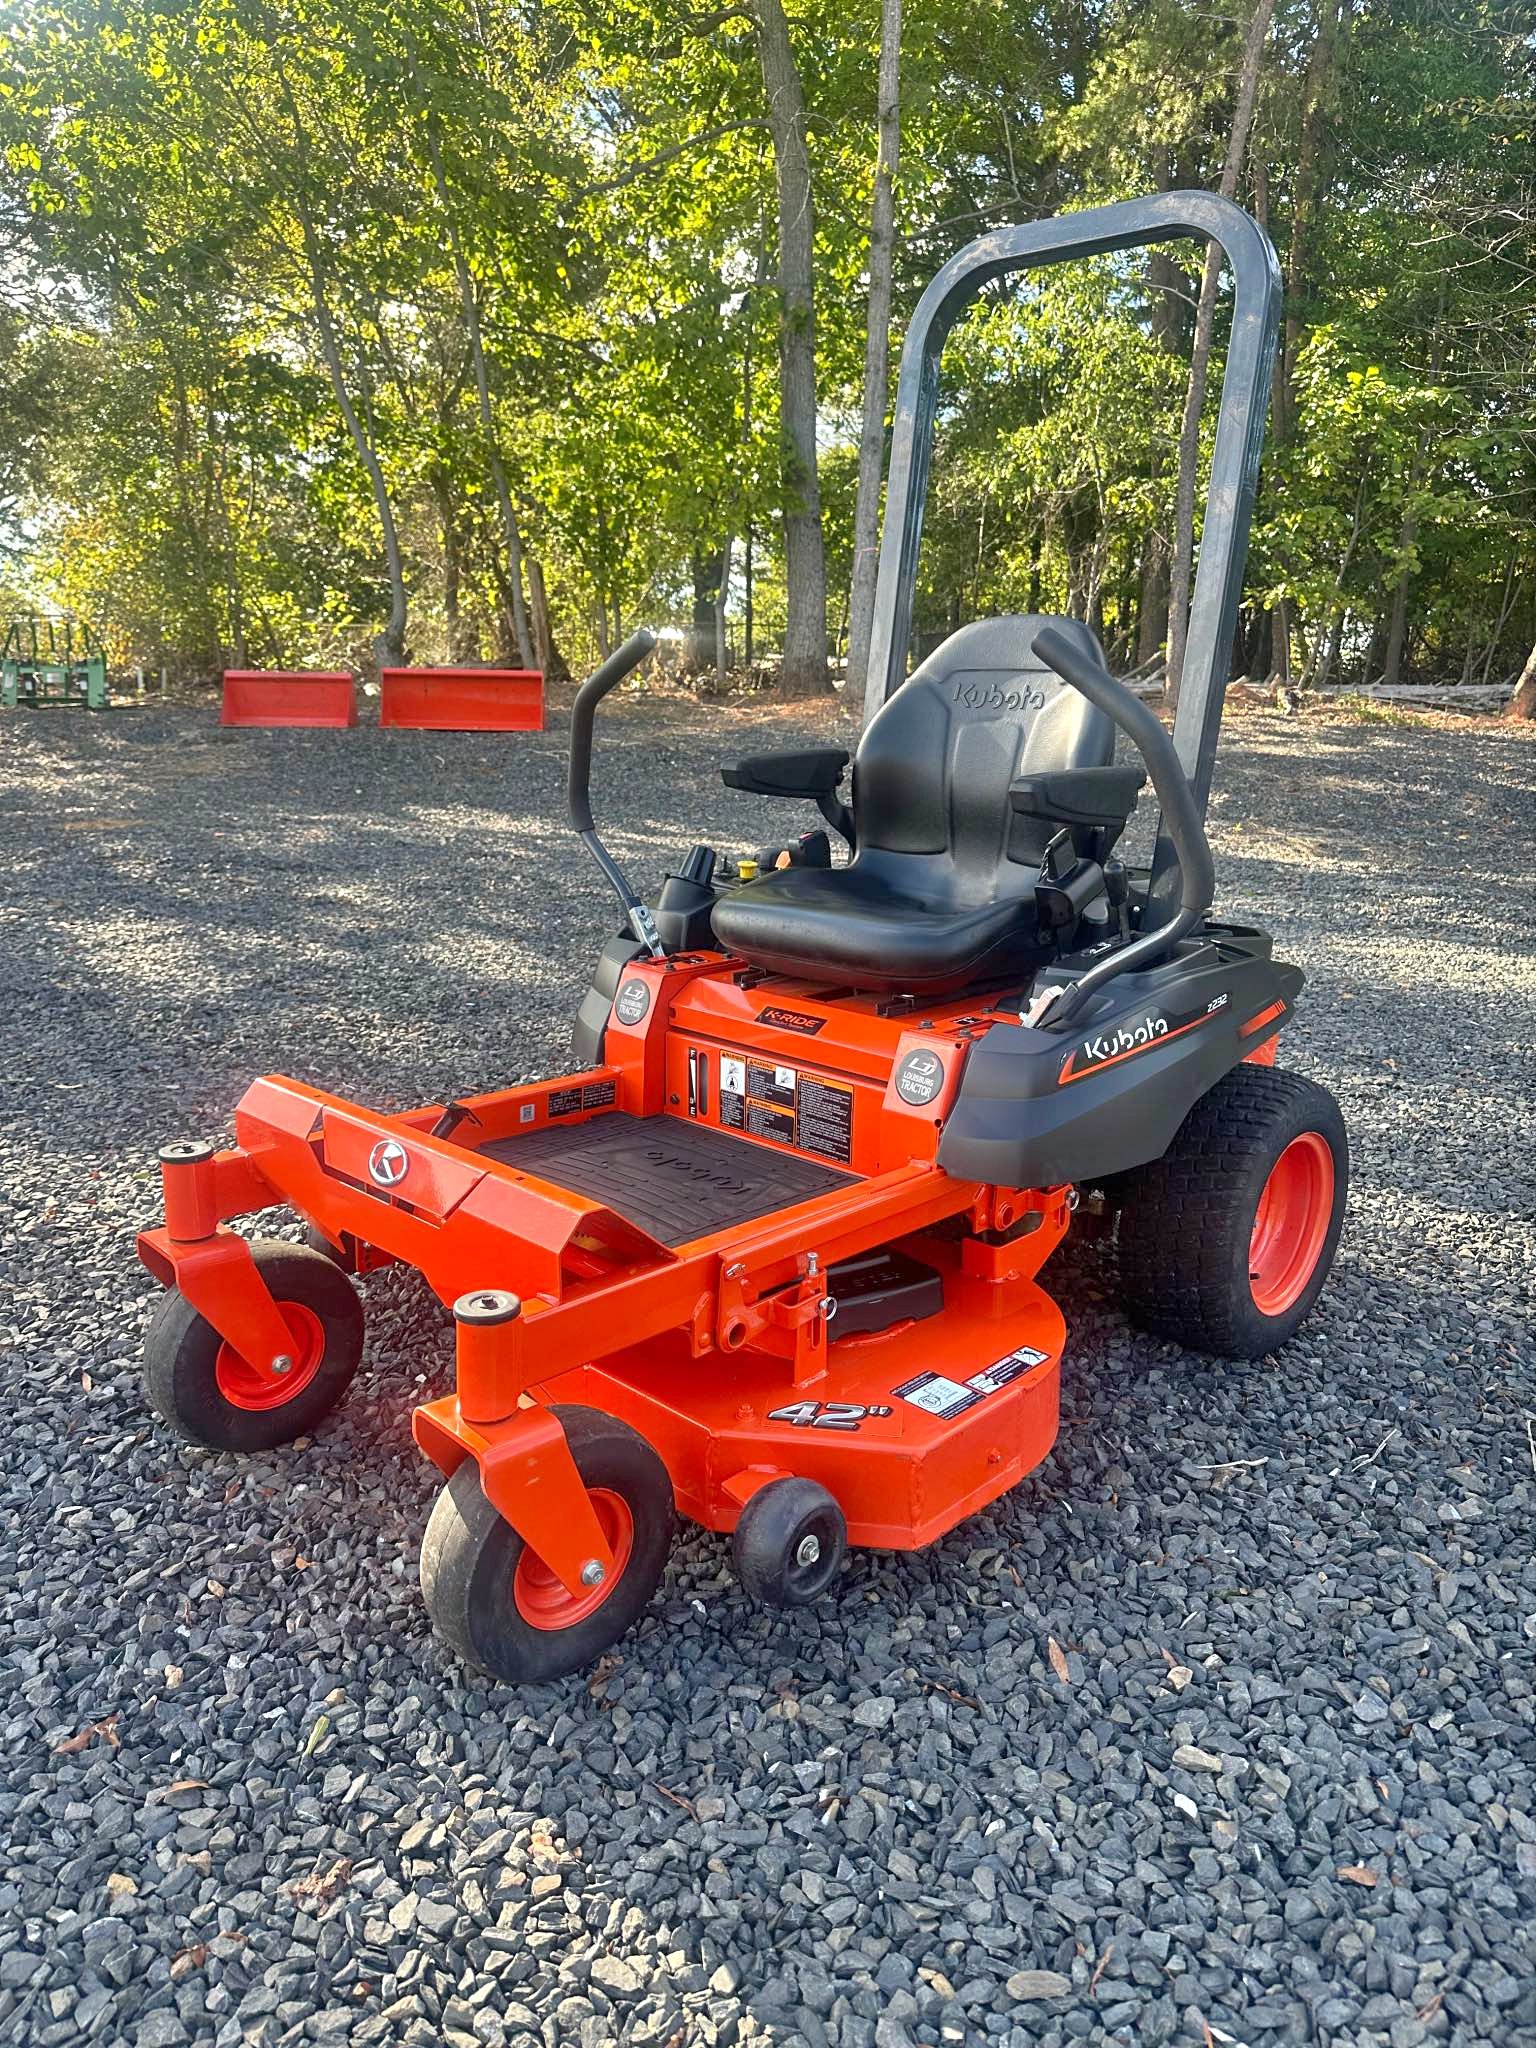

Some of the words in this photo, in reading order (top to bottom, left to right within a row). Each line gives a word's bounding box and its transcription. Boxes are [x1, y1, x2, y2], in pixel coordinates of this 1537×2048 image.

[952, 681, 1046, 710] Kubota
[765, 1010, 820, 1028] K-RIDE
[1083, 1017, 1169, 1060] Kubota
[901, 1078, 932, 1098] TRACTOR
[903, 1070, 935, 1087] LOUISBURG
[645, 1151, 754, 1196] Kubota
